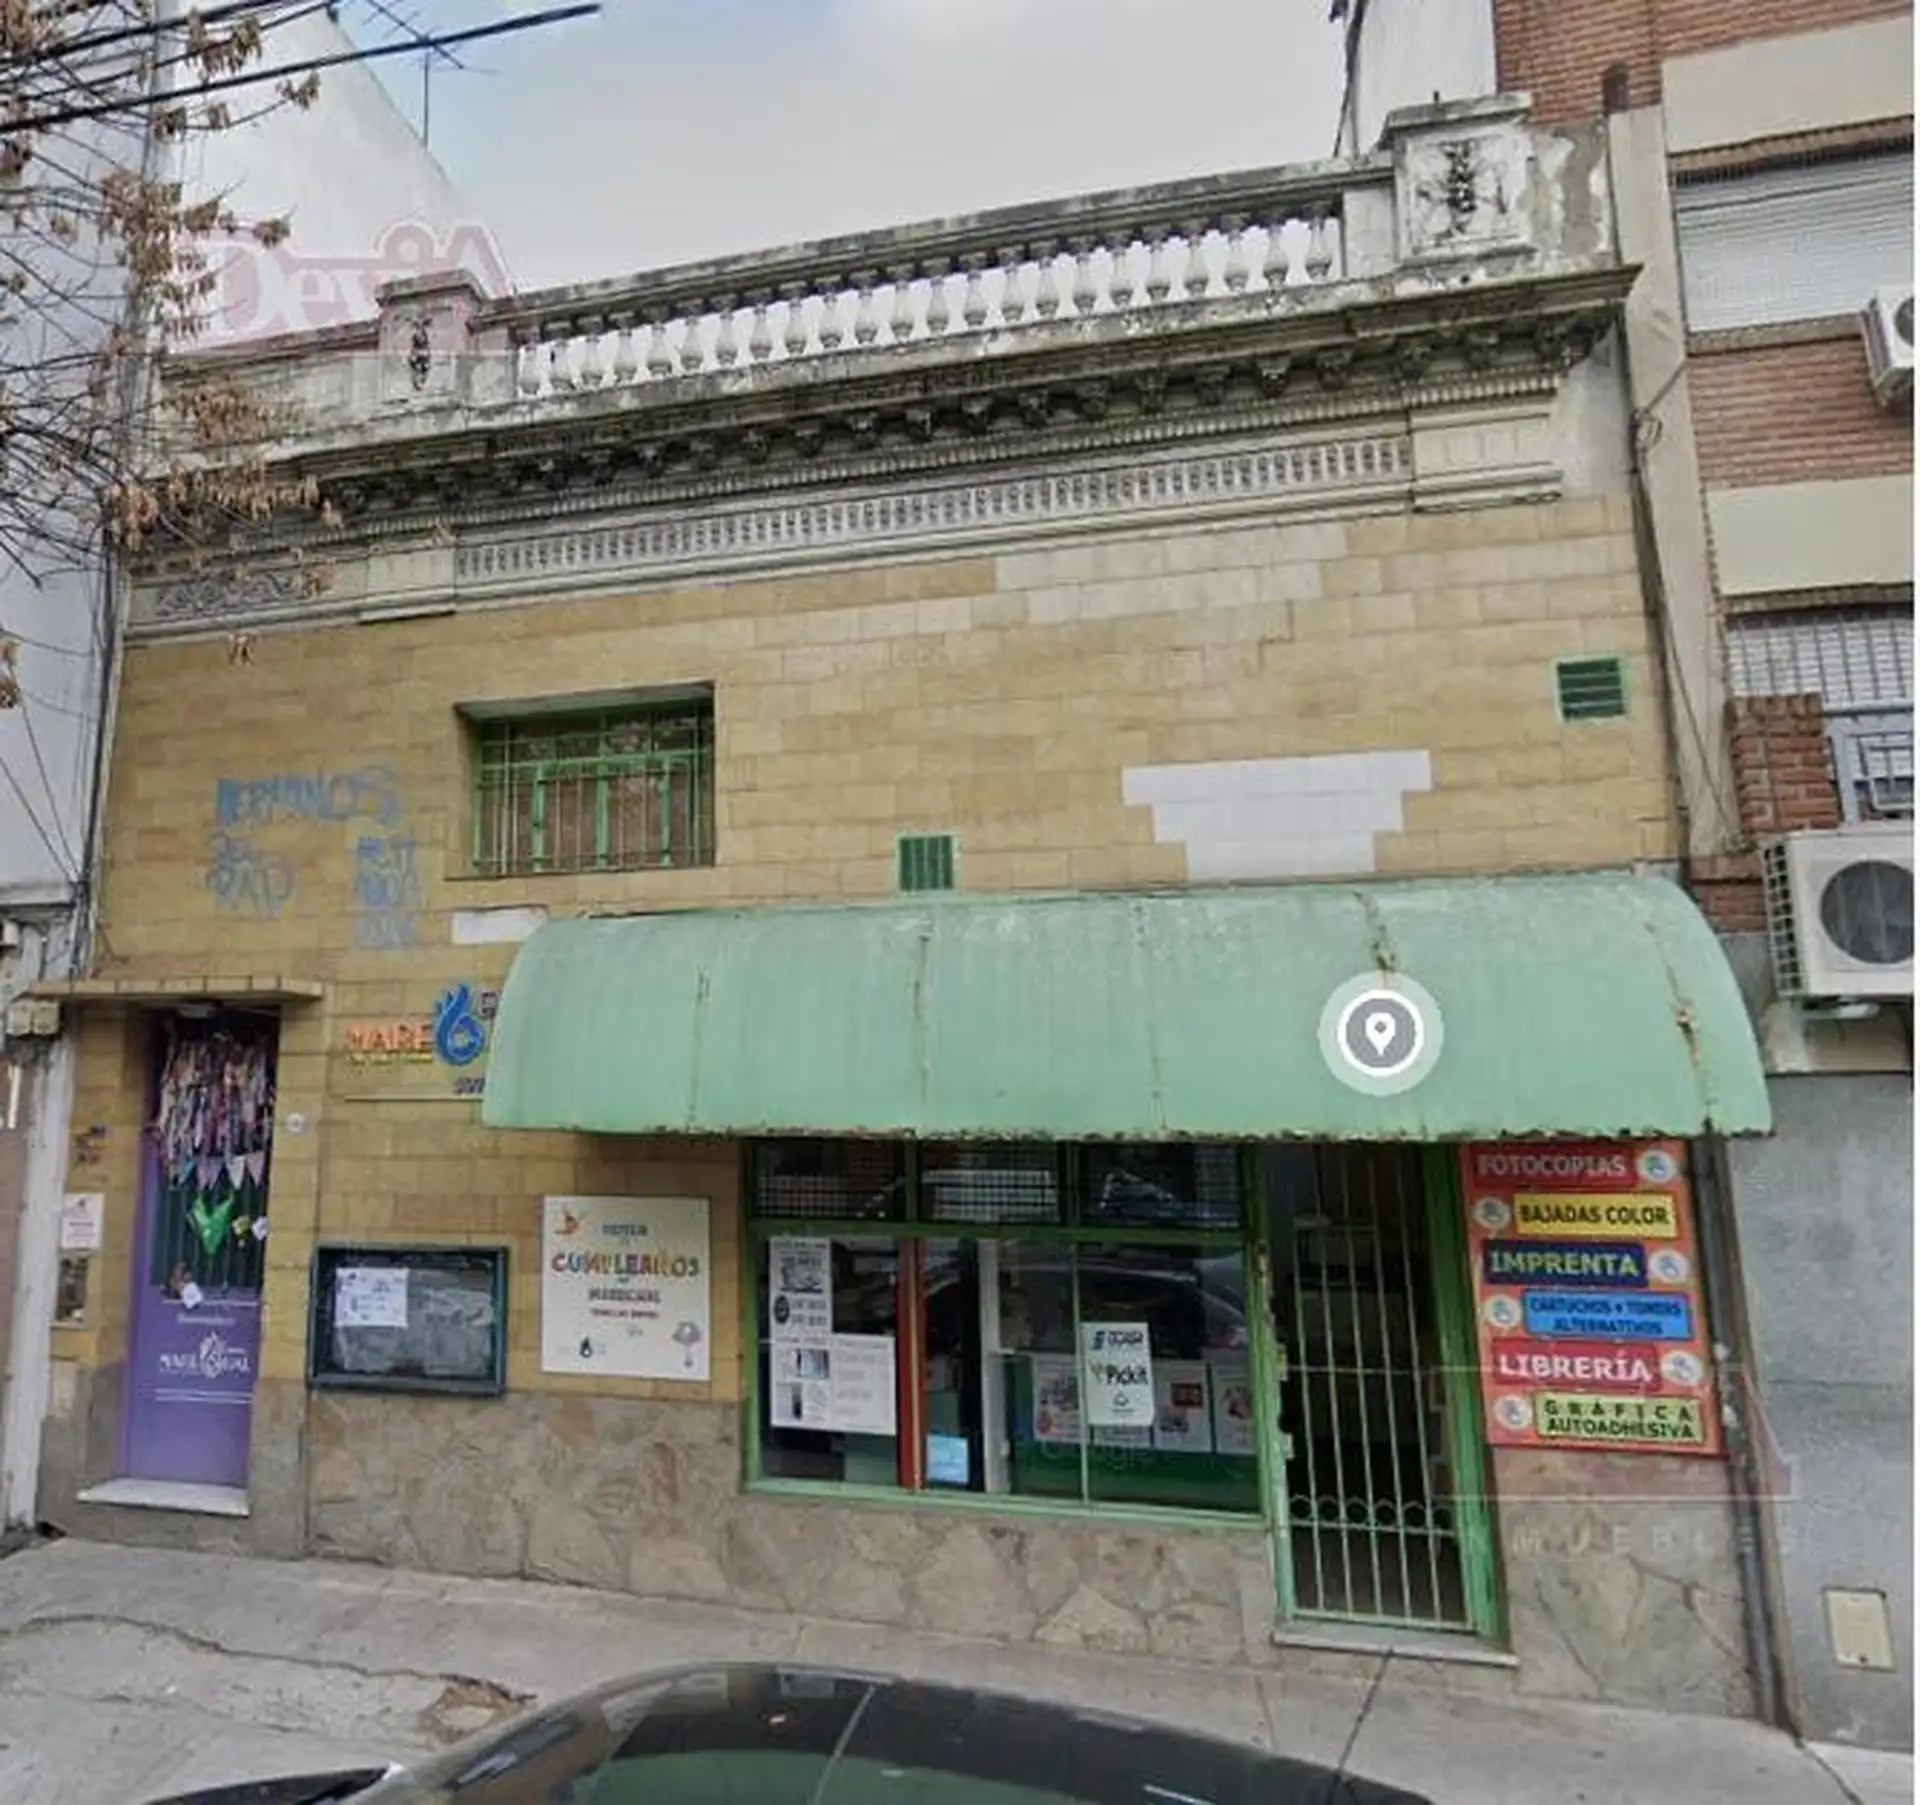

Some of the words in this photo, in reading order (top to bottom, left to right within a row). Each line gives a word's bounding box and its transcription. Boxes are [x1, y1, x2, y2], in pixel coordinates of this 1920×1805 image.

[1477, 1154, 1627, 1177] FOTOCOPIAS
[1518, 1203, 1602, 1224] BAJADAS
[1604, 1206, 1669, 1226] COLOR
[1490, 1250, 1640, 1278] IMPRENTA
[1552, 1317, 1664, 1335] ALTERNATIVOS
[1499, 1351, 1651, 1383] LIBRERÍA
[1546, 1417, 1696, 1439] AUTOADHESIVA
